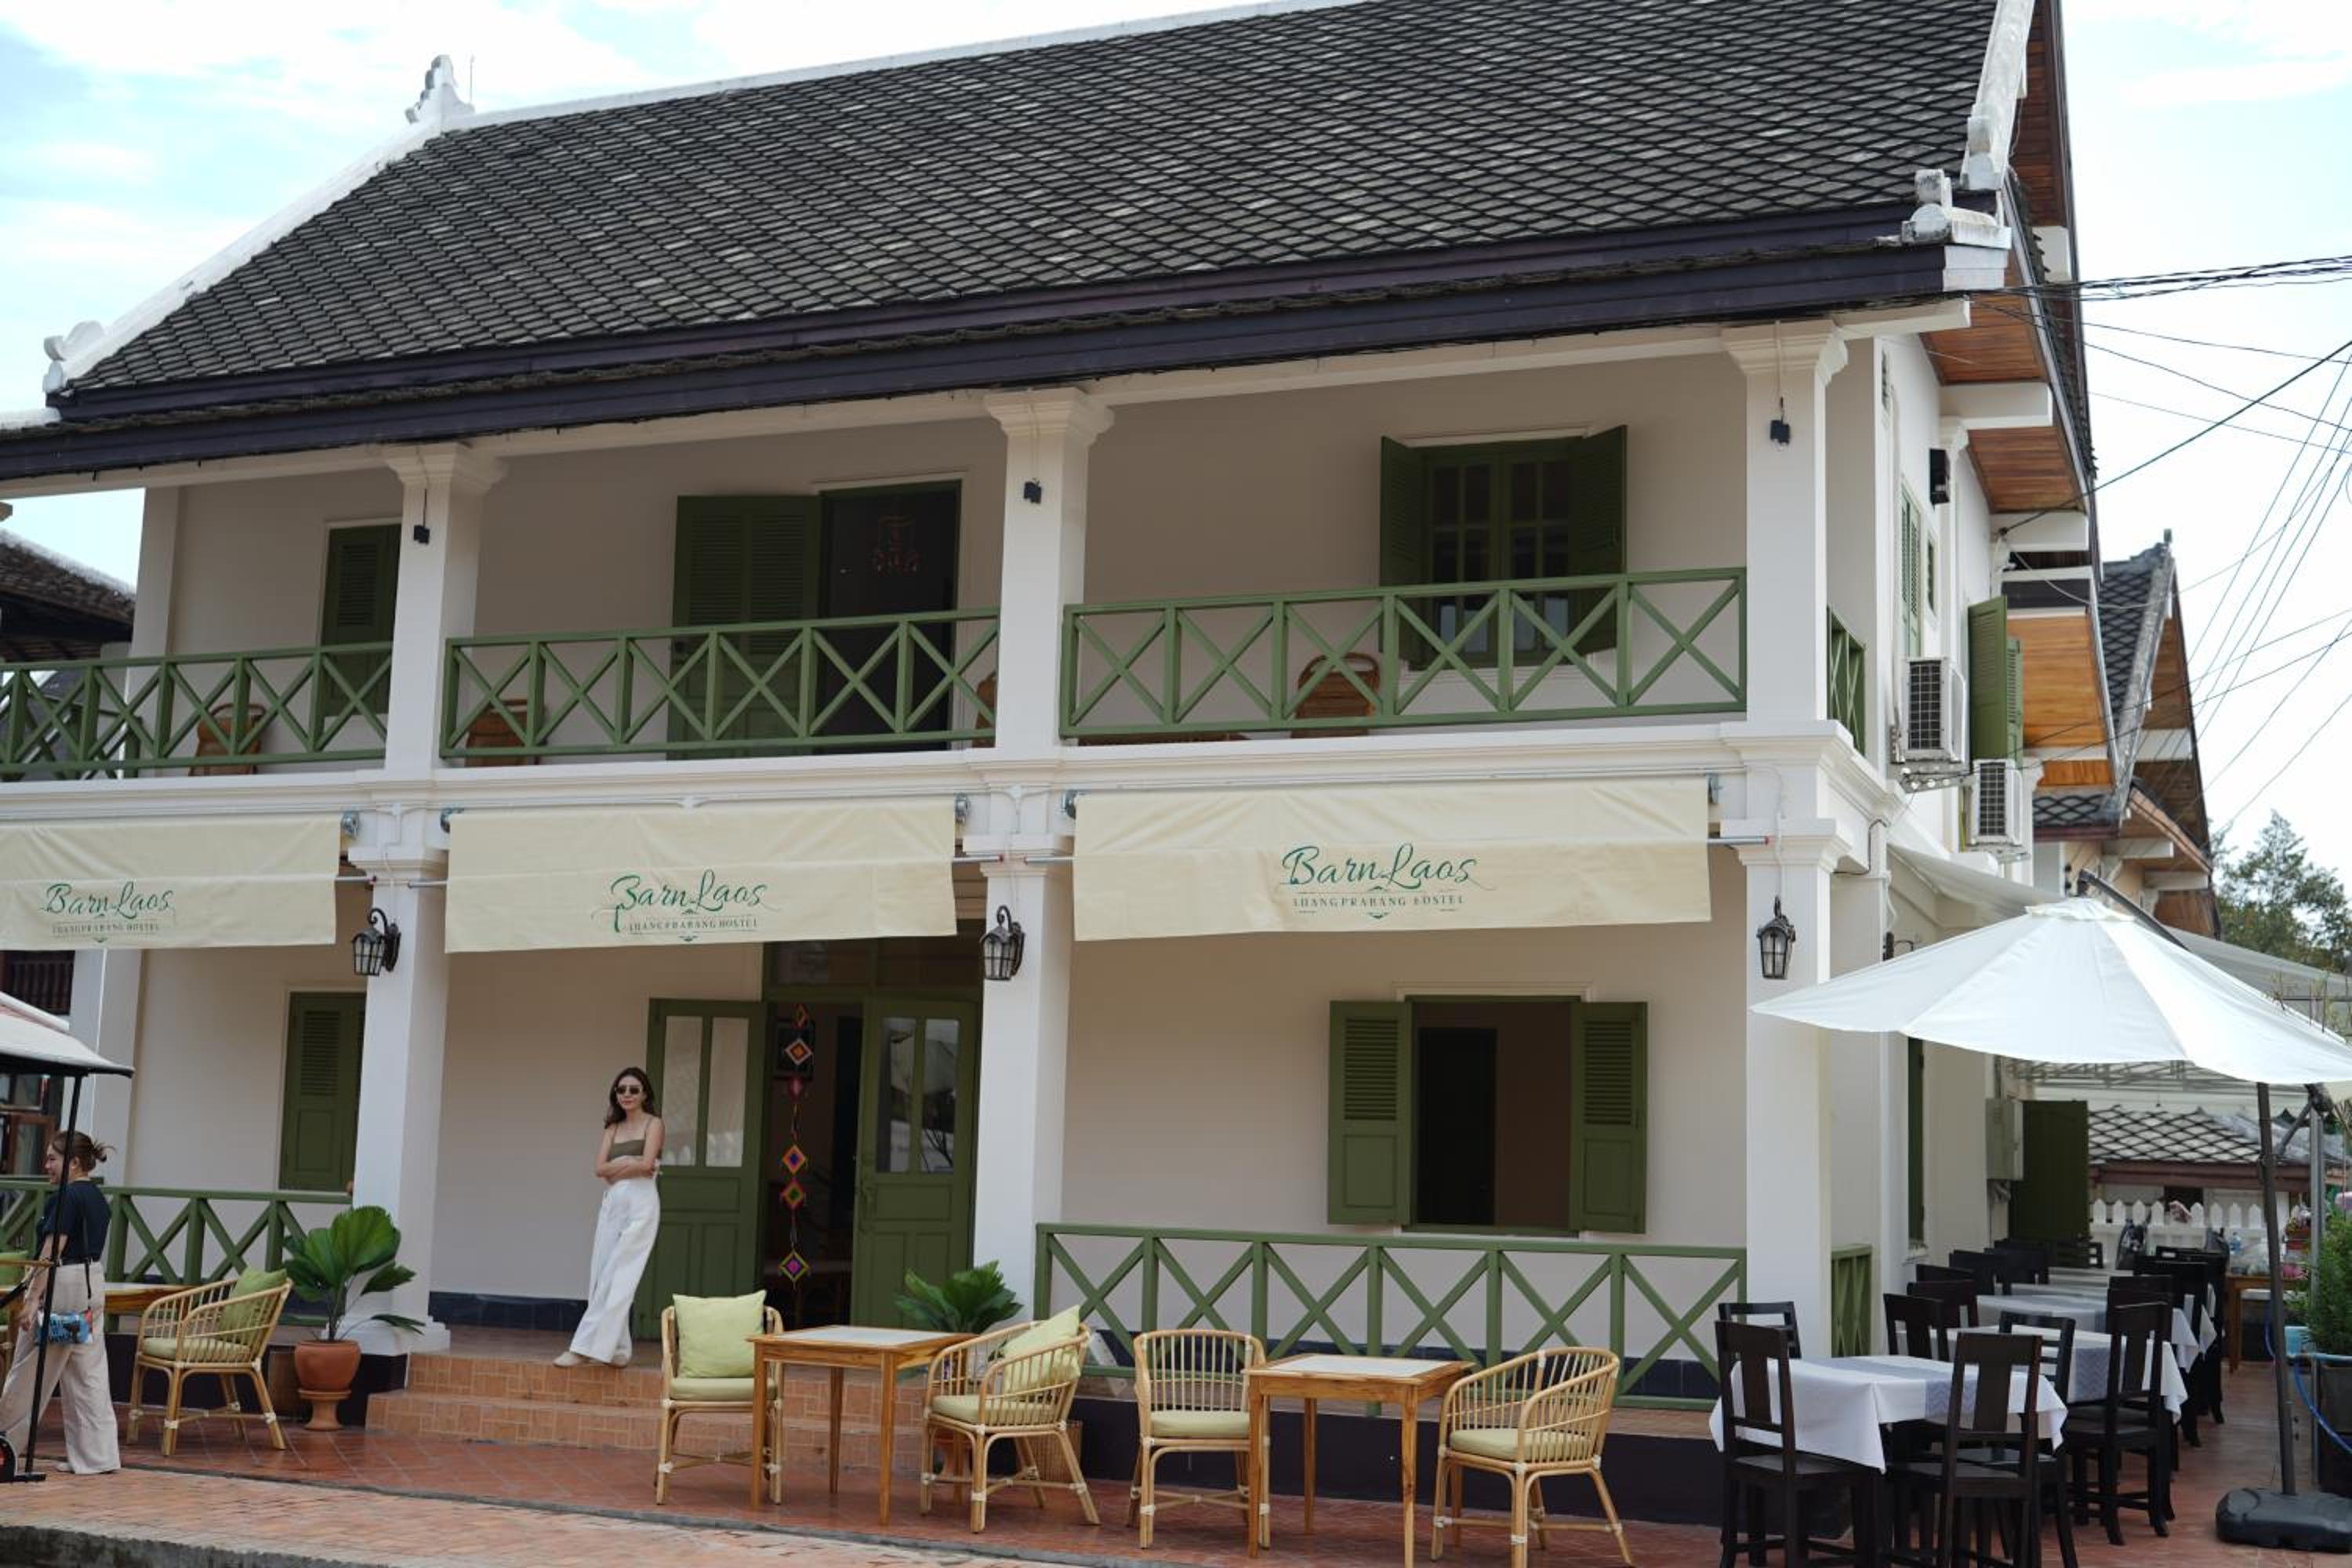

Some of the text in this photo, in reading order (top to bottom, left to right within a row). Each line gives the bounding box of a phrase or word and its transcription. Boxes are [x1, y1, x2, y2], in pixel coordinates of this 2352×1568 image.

[1281, 843, 1480, 890] Barn Laos
[45, 880, 174, 920] Barn Laos
[611, 868, 768, 932] Barn Laos
